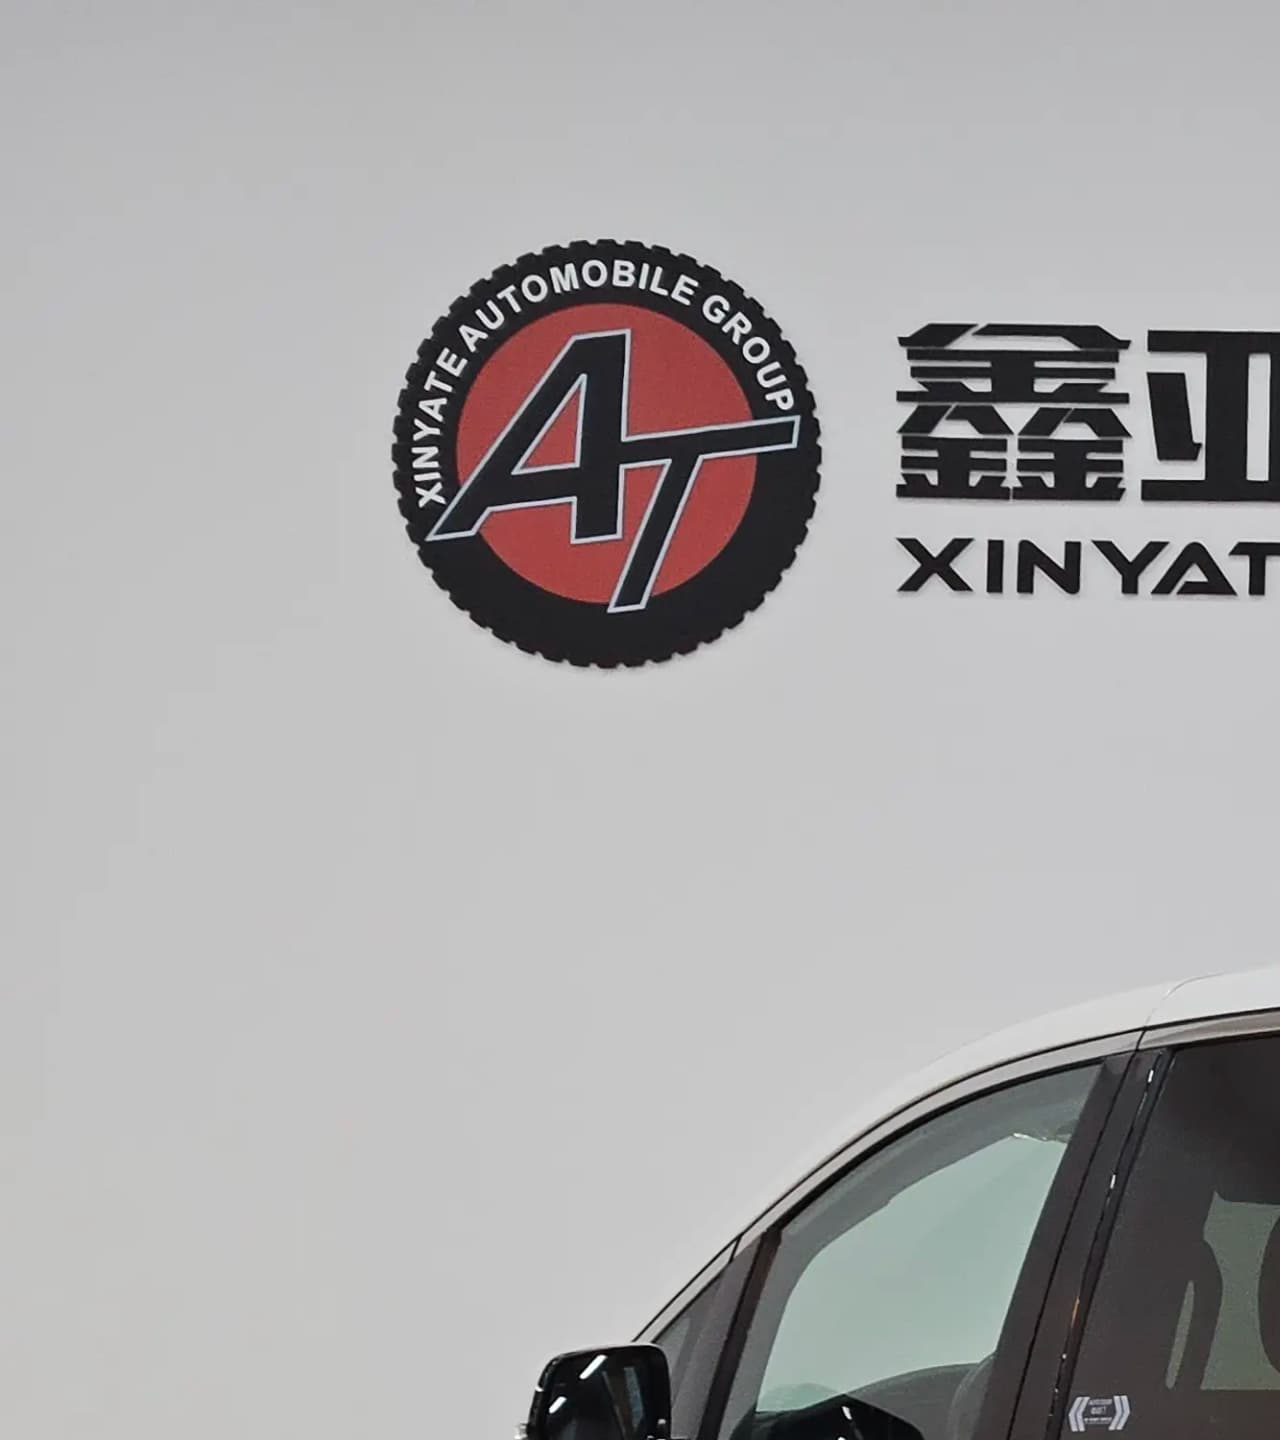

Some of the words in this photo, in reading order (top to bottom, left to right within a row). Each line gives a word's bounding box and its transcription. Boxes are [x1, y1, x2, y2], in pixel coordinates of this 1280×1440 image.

[411, 347, 467, 509] XINYATE
[461, 258, 700, 354] AUTOMOBILE
[700, 293, 796, 412] GROUP
